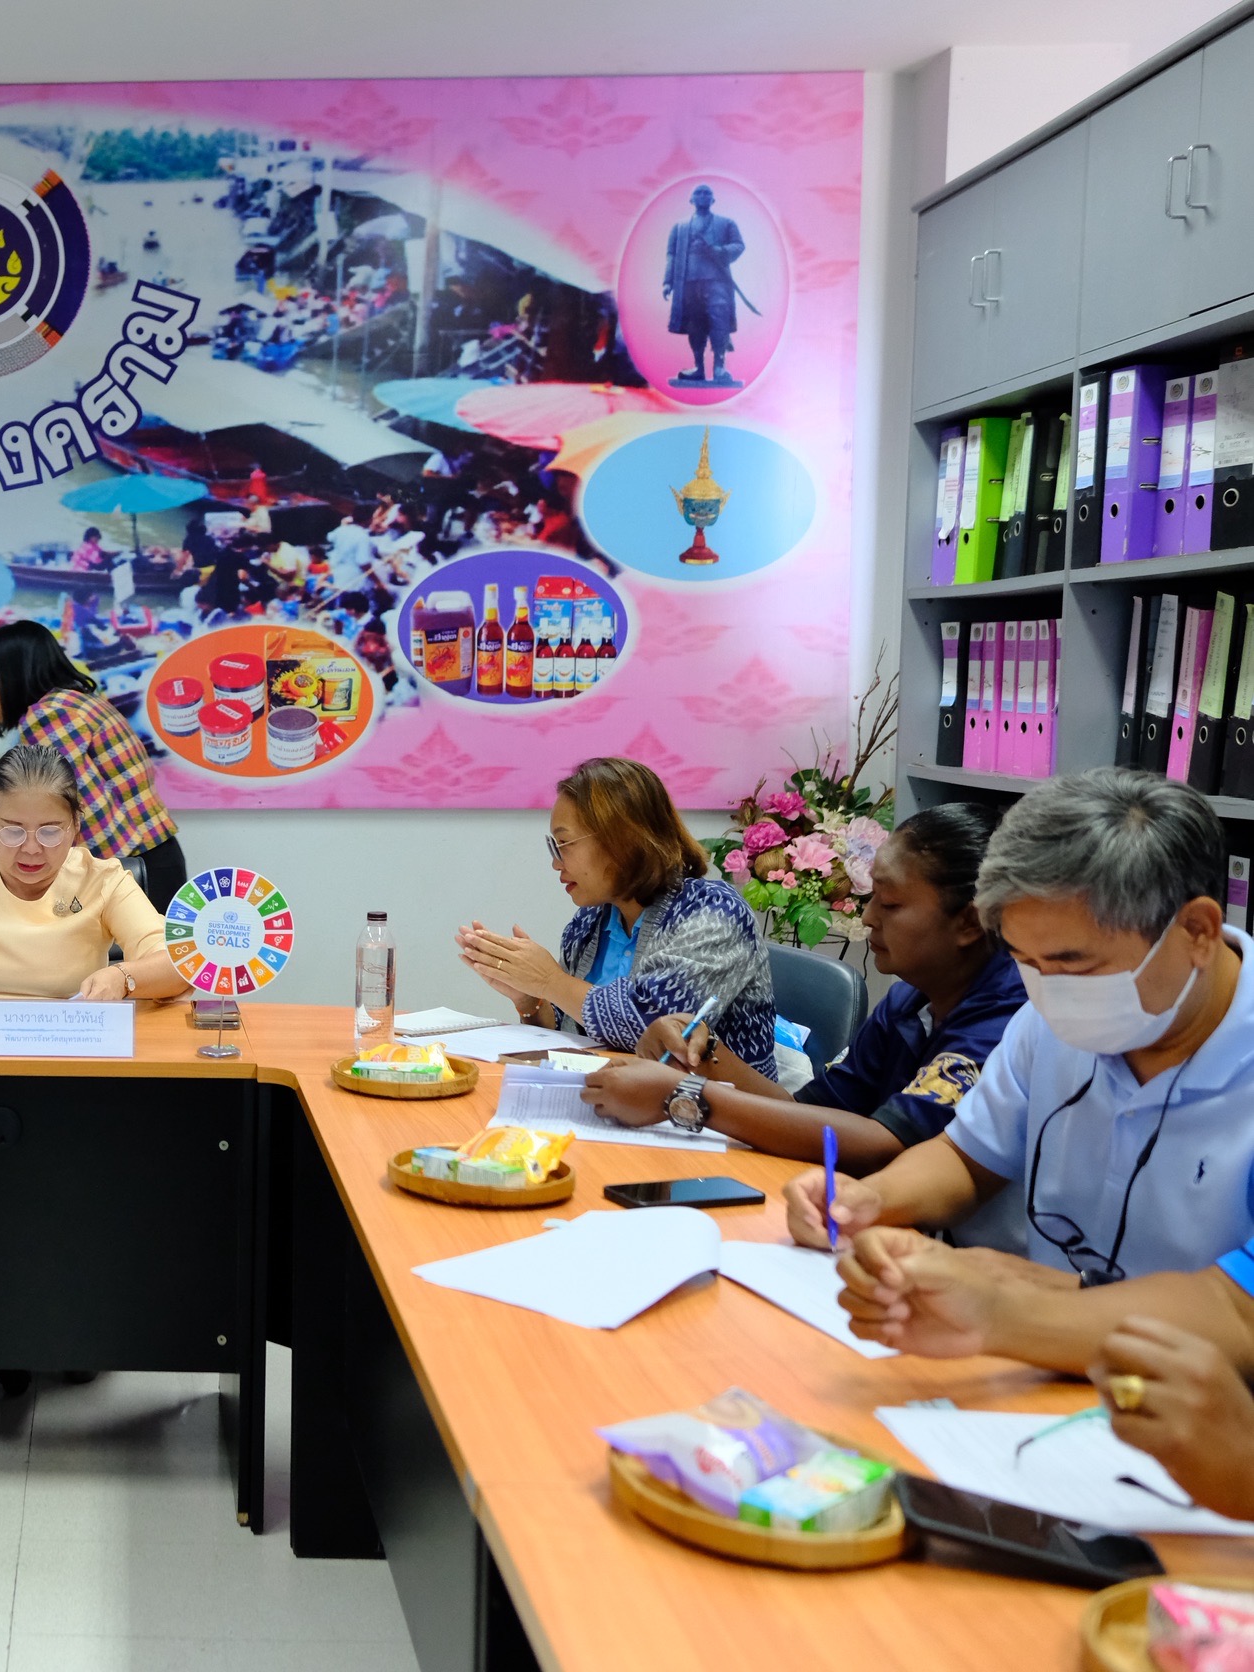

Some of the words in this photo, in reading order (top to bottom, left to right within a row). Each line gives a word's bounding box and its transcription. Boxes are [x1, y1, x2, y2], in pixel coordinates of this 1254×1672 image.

[208, 922, 251, 931] SUSTAINABLE
[207, 928, 250, 937] DEVELOPMENT
[207, 935, 250, 949] GOALS
[3, 1012, 60, 1024] นางวาสนา
